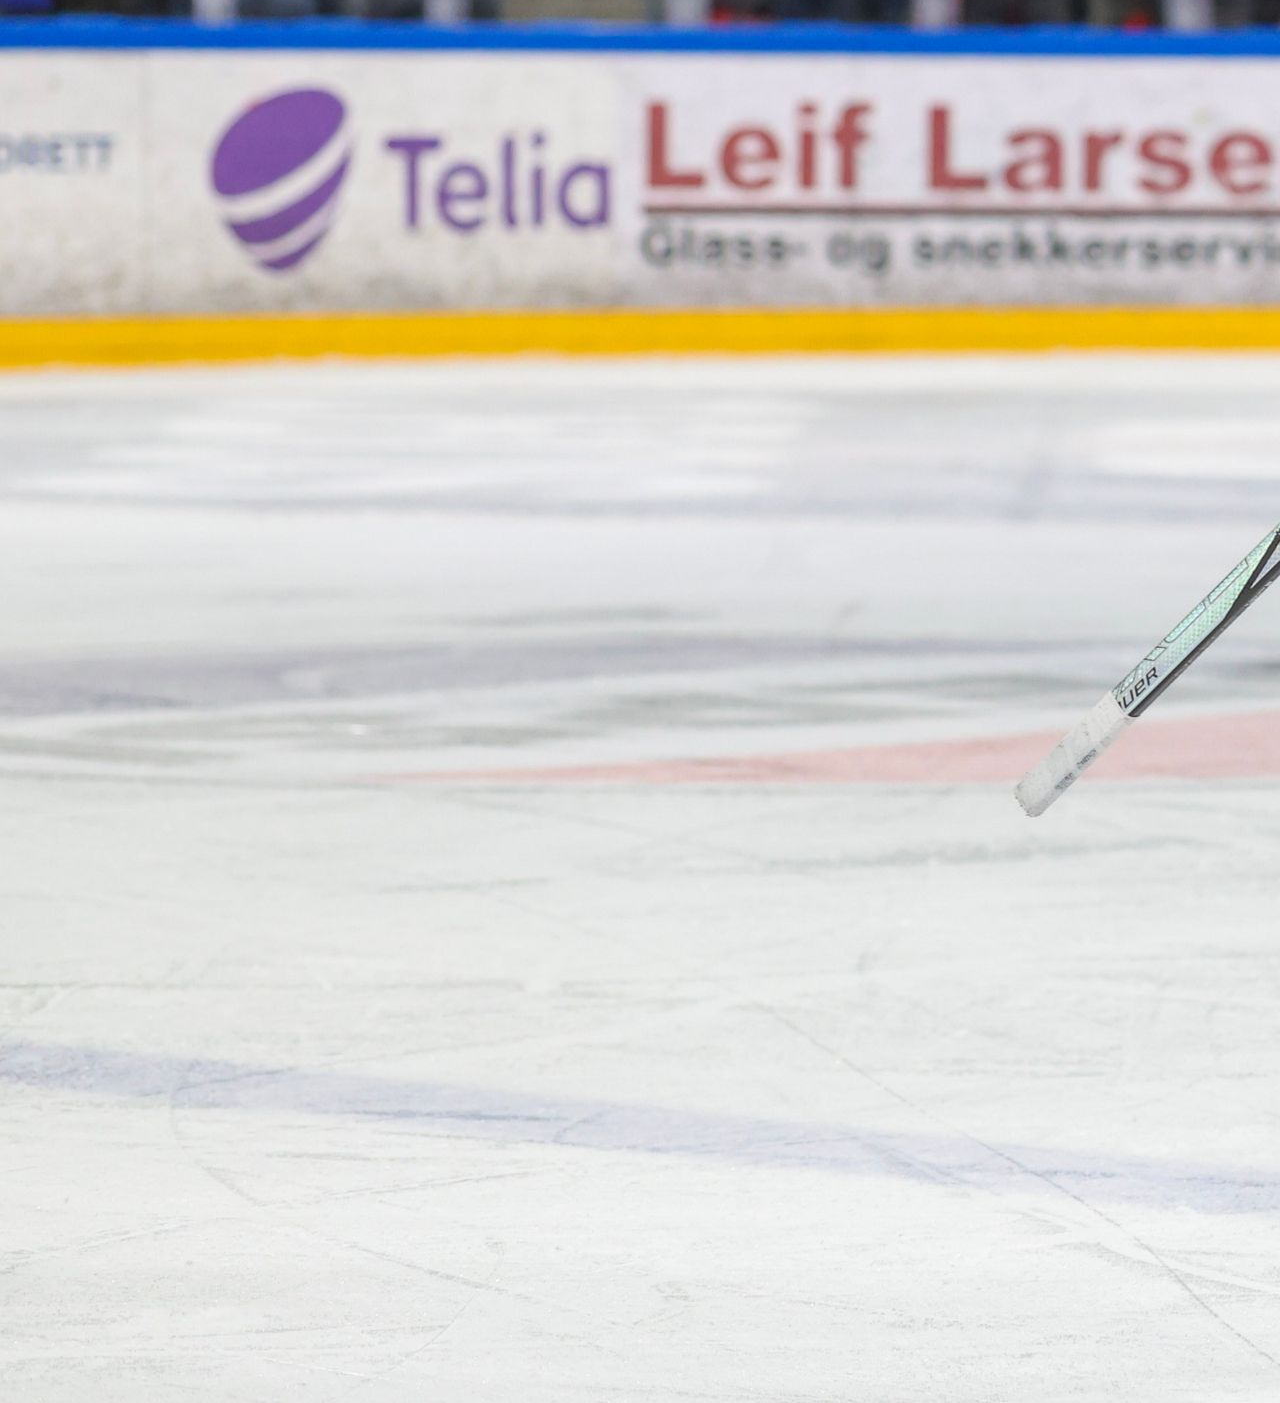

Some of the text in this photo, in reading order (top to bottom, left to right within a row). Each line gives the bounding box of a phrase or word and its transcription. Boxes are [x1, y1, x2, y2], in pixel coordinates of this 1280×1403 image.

[385, 136, 611, 232] Telia
[646, 102, 866, 190] Leif
[826, 228, 891, 273] og
